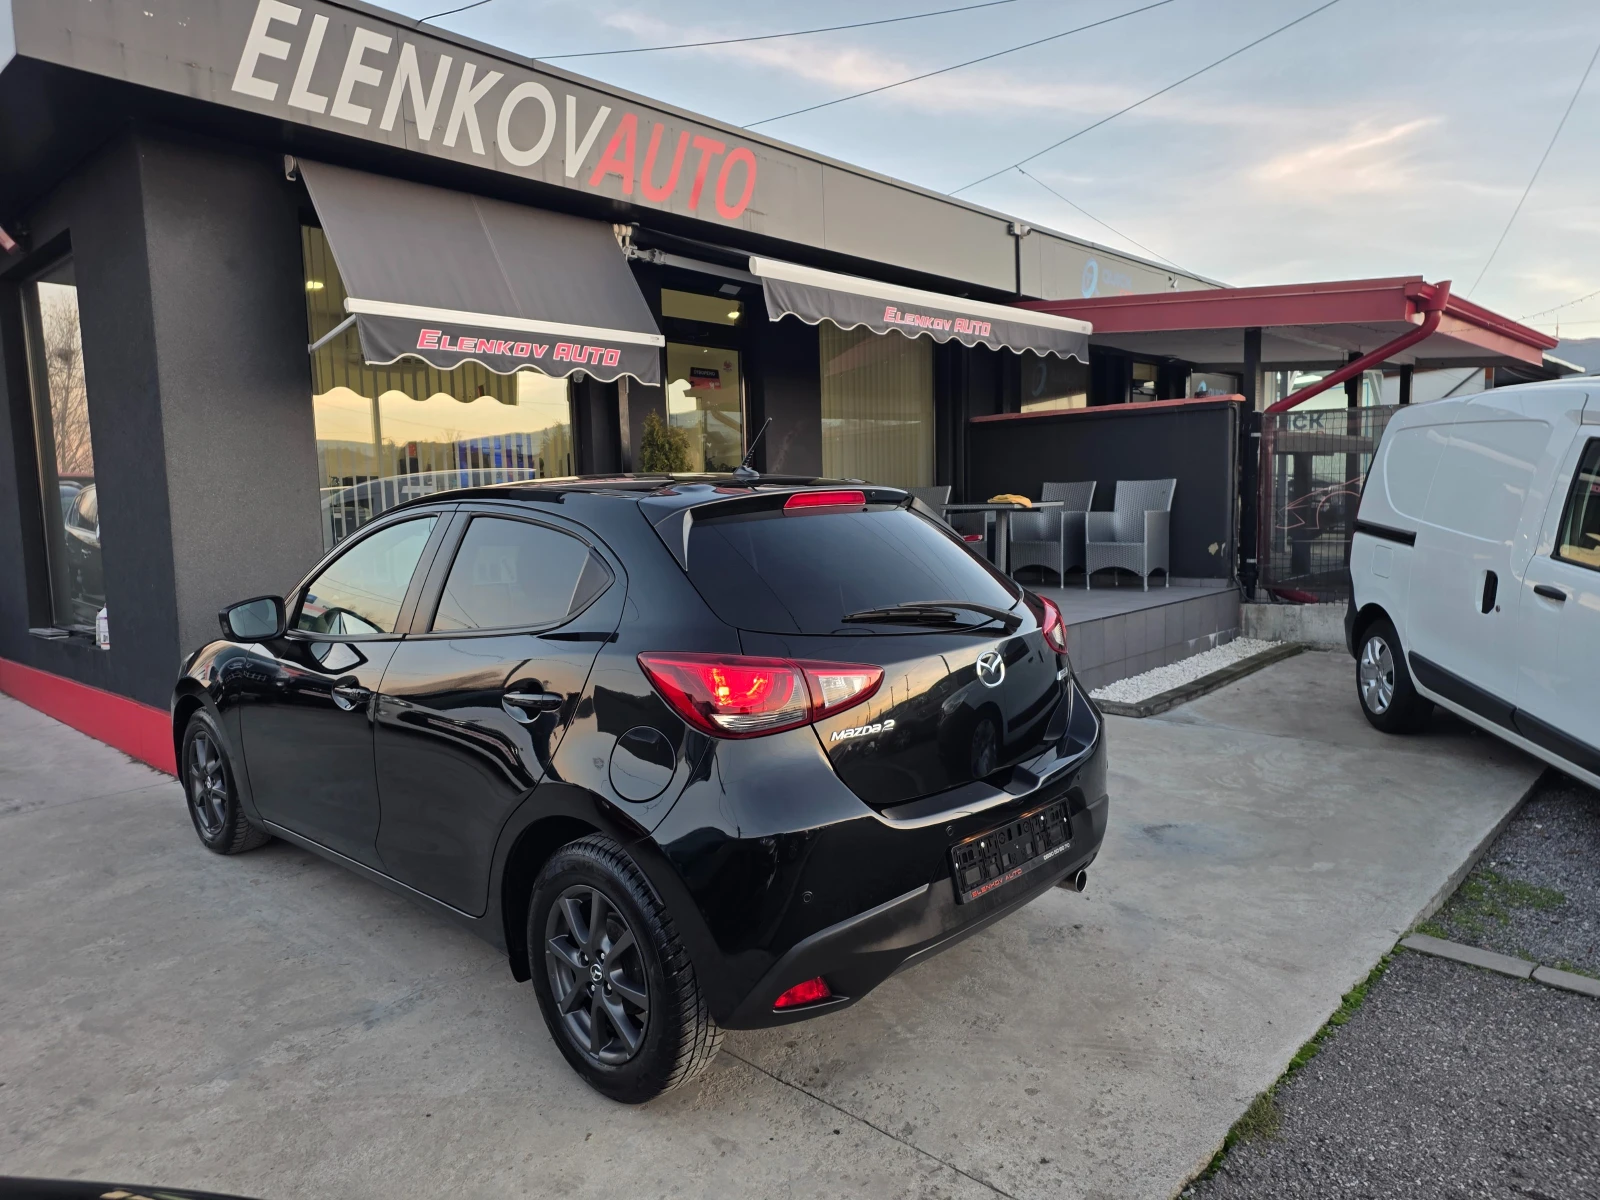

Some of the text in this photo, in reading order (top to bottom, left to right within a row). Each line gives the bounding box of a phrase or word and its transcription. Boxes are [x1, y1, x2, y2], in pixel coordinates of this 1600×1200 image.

[883, 306, 991, 337] ELENKOV AUTO
[416, 328, 621, 366] ELENKOV AUTO
[1005, 867, 1023, 881] AUTO
